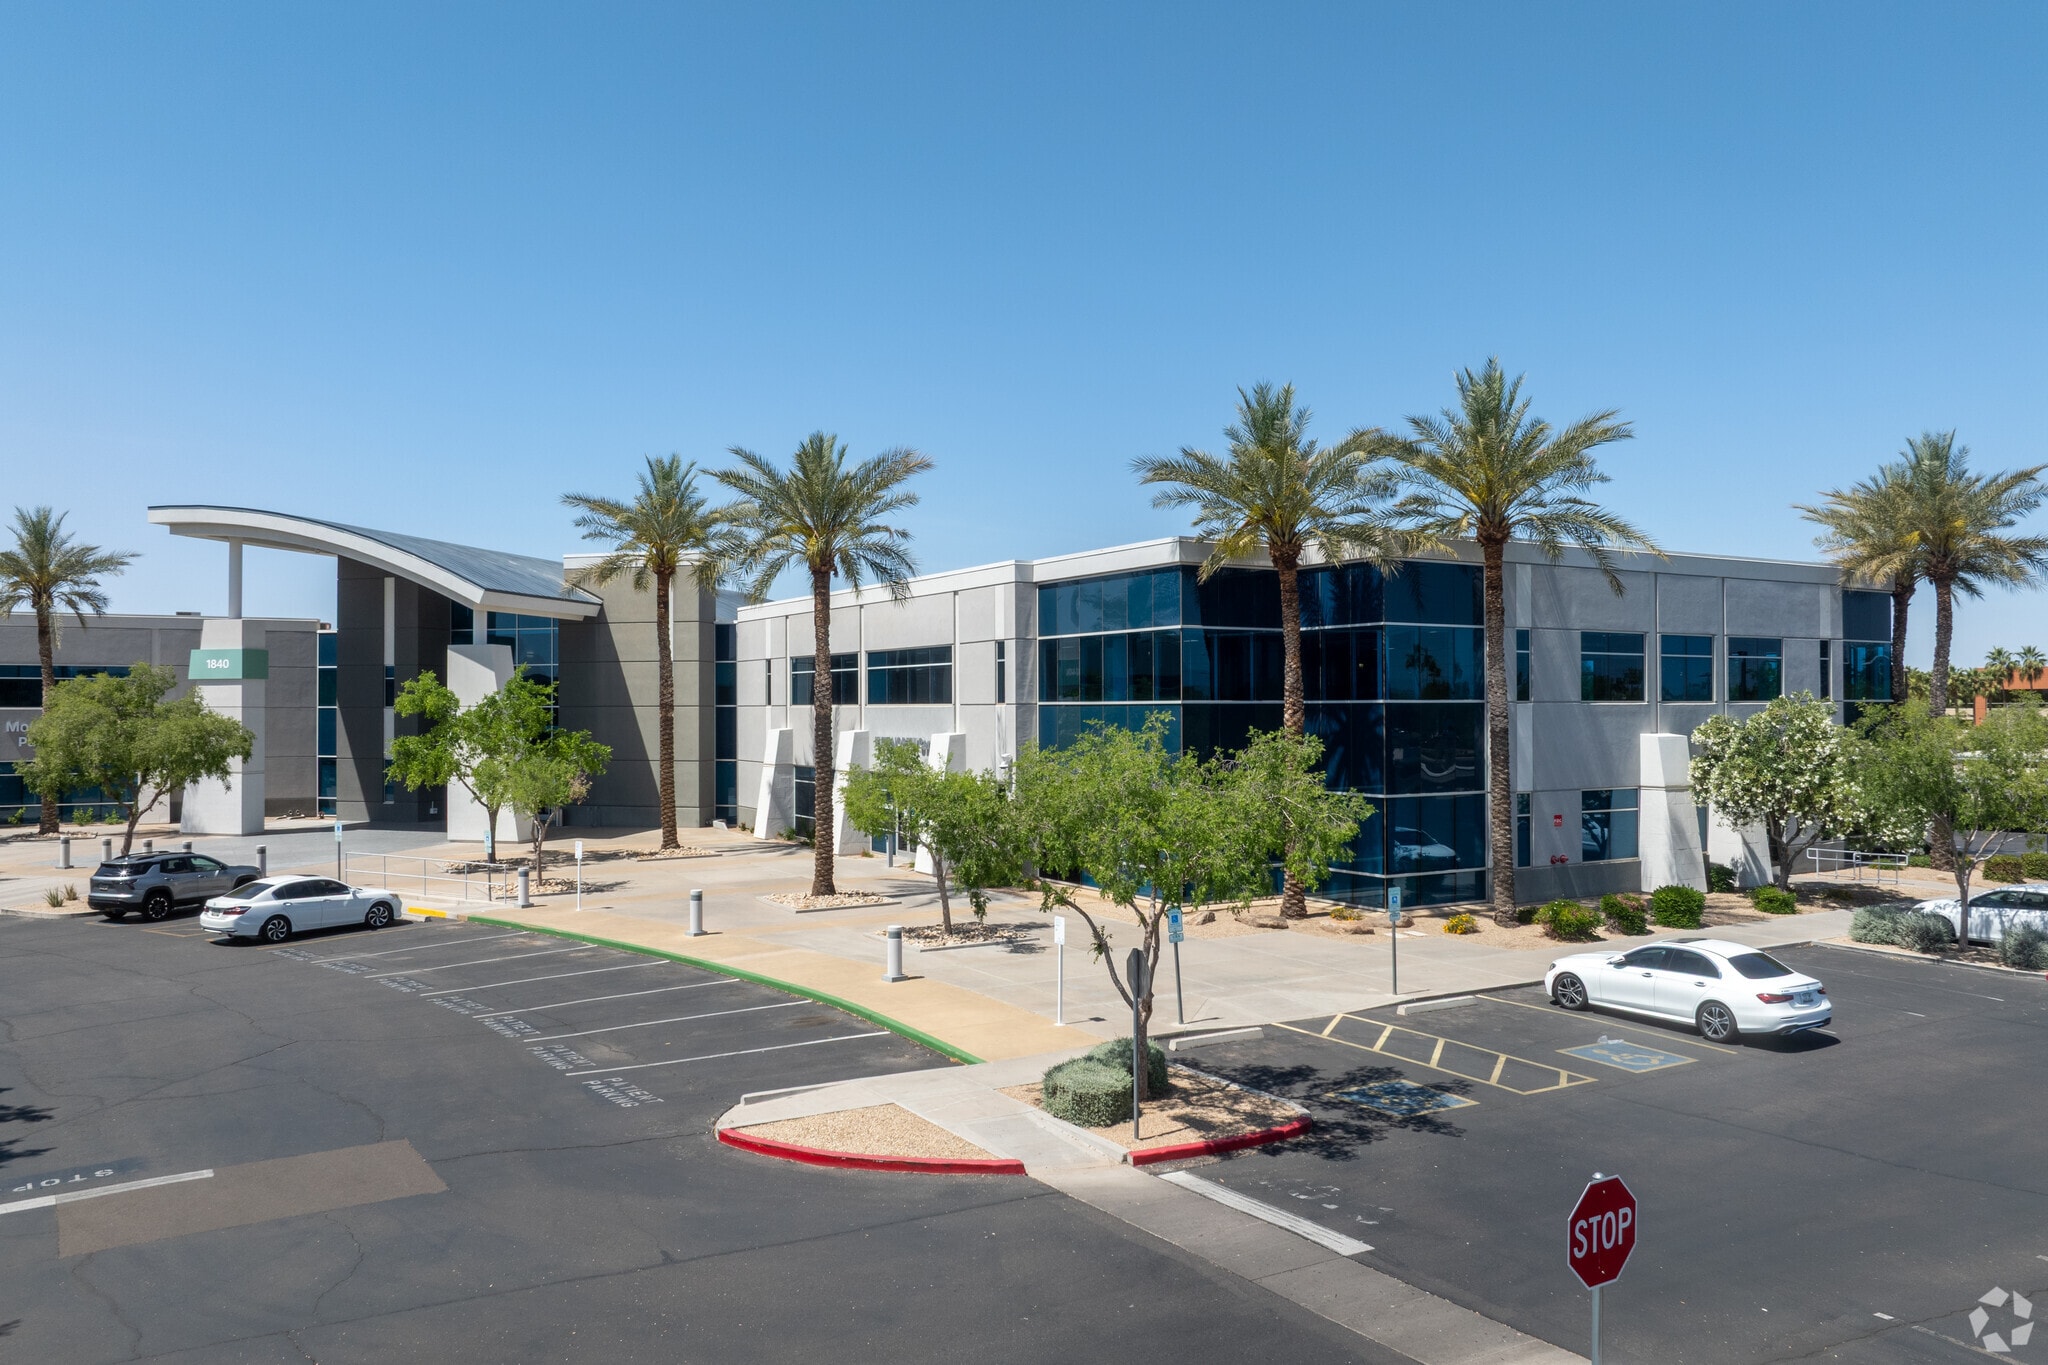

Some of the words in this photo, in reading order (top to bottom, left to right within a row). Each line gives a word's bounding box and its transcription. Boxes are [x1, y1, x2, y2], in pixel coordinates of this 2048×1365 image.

[206, 659, 230, 669] 1840
[478, 1018, 521, 1038] PARKING
[496, 1015, 541, 1036] PATIENT
[526, 1046, 574, 1071] PARKING
[547, 1044, 596, 1068] PATIENT
[581, 1079, 640, 1108] PARKING
[603, 1077, 665, 1104] PATIENT
[12, 1169, 114, 1192] STOP
[1573, 1206, 1632, 1259] STOP
